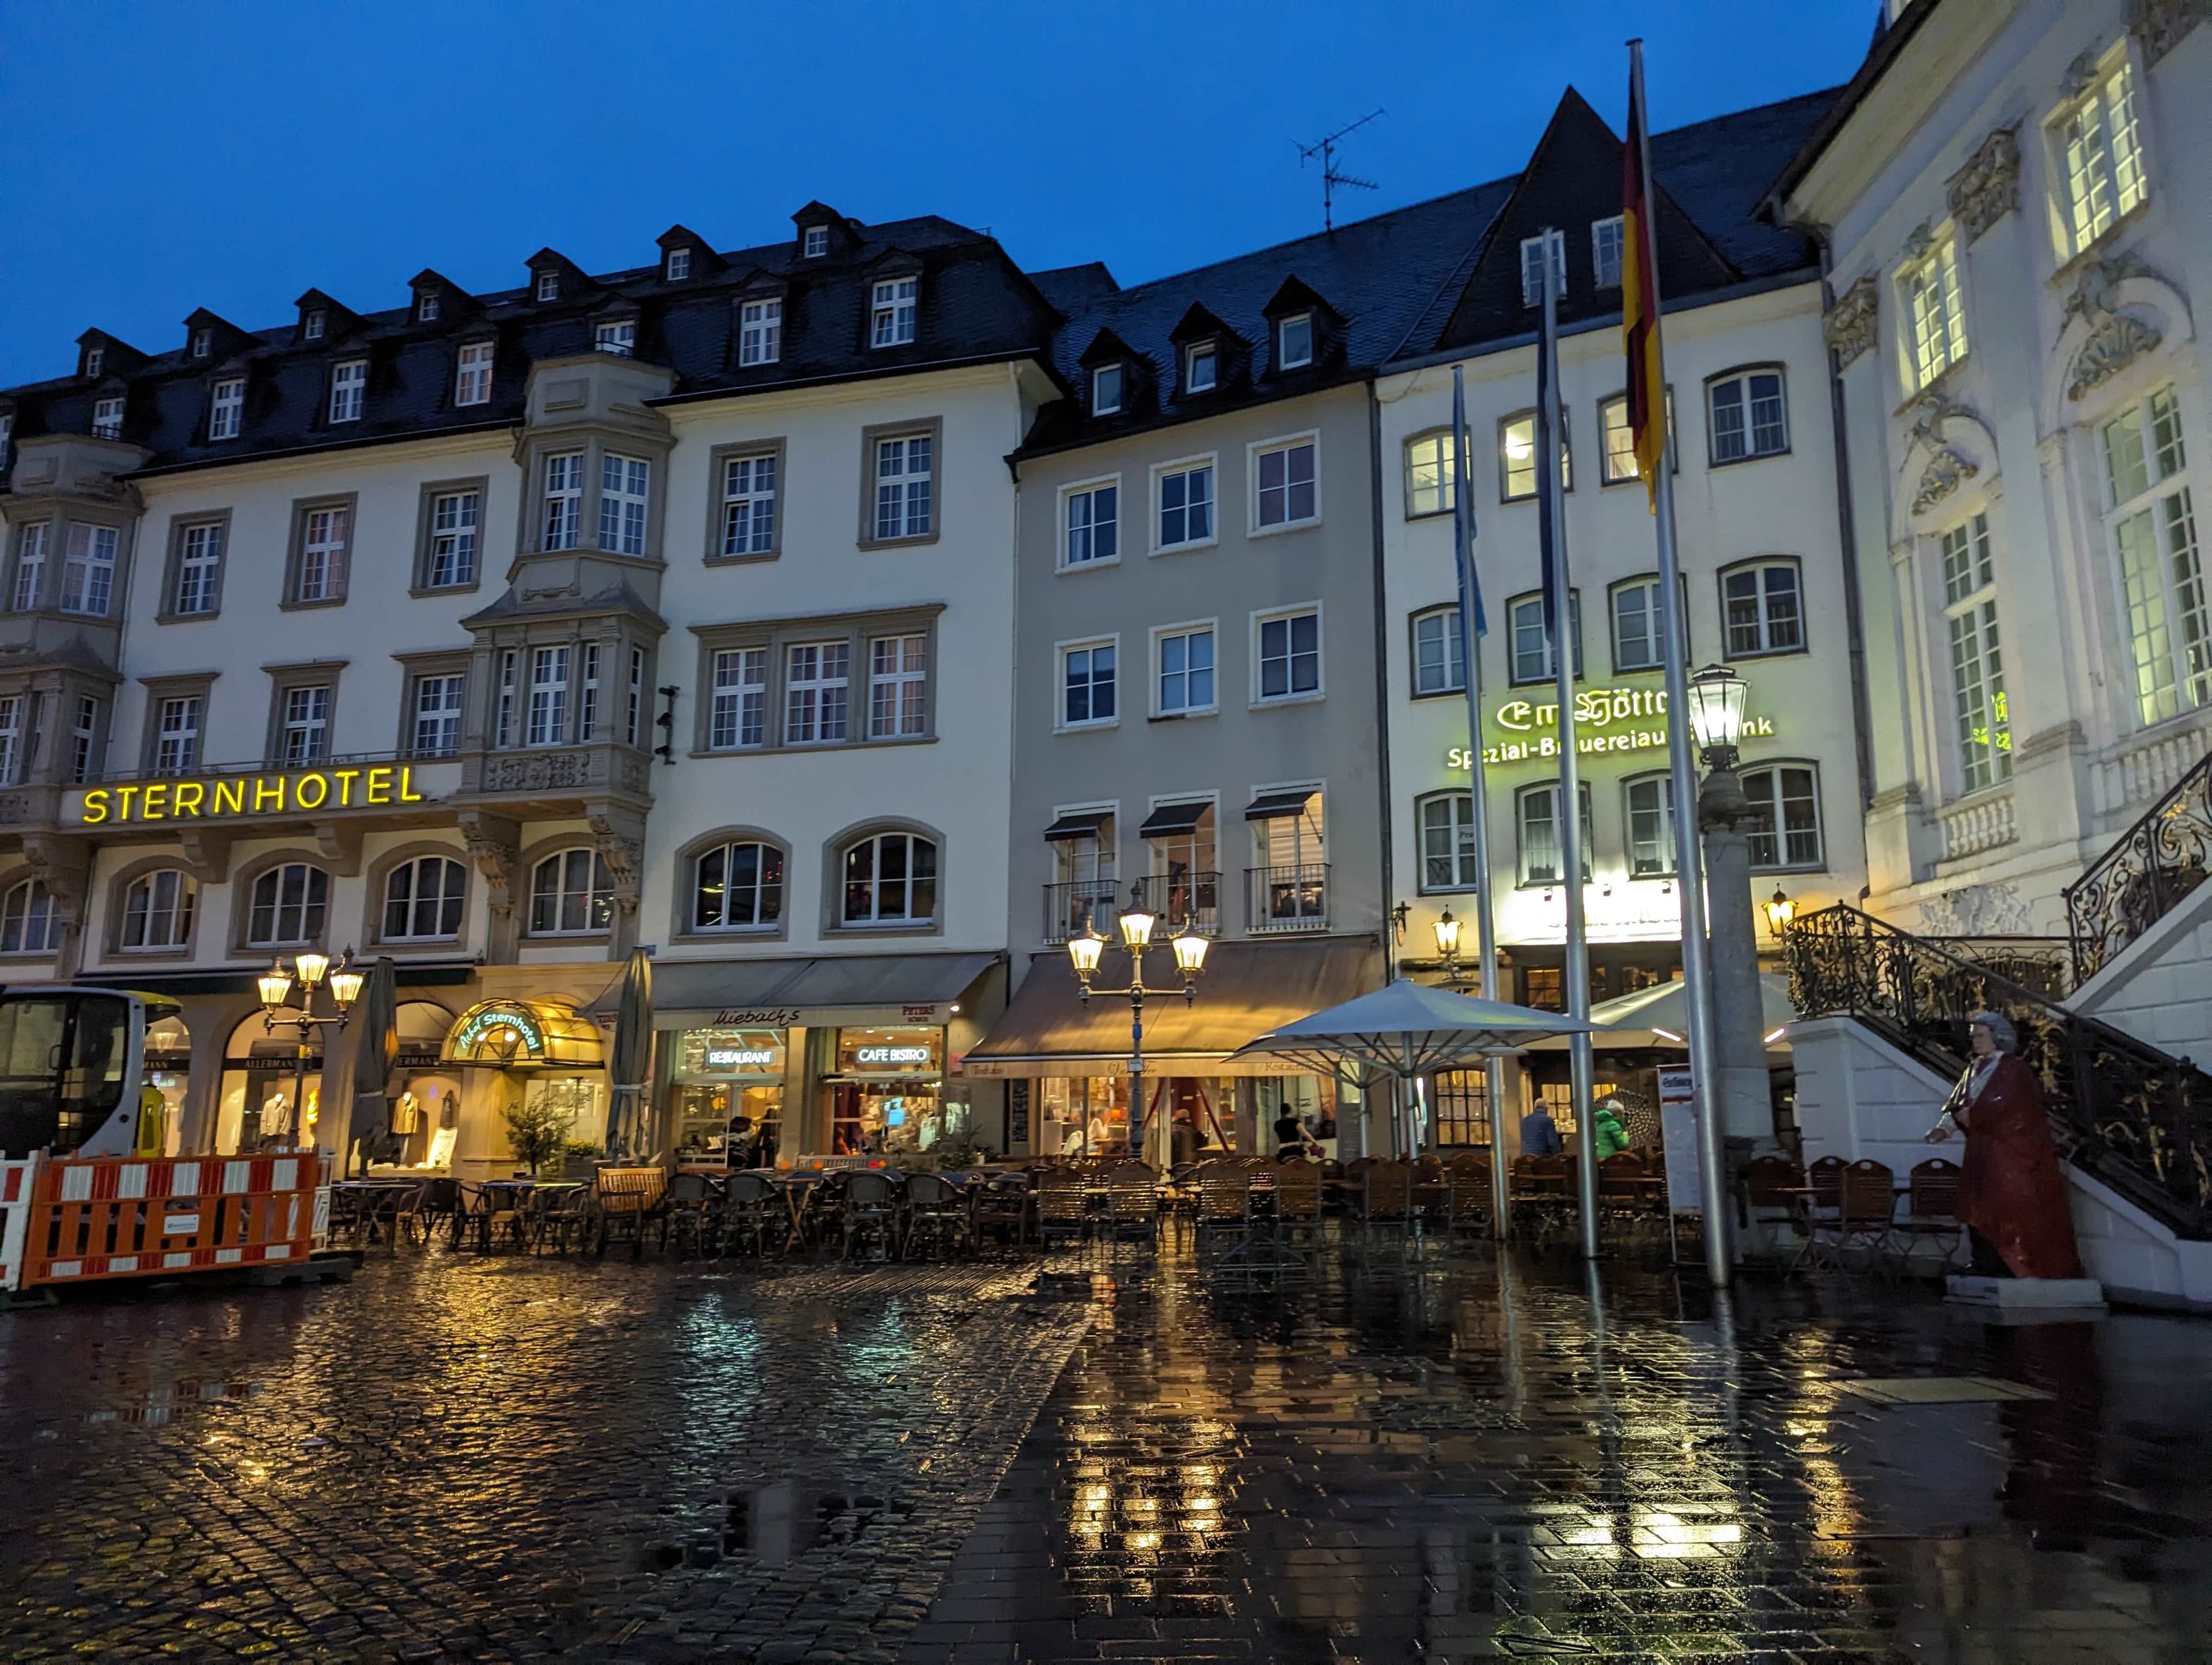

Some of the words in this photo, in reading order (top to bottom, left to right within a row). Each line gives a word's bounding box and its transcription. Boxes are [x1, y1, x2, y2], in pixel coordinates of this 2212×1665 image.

[82, 767, 421, 824] STERNHOTEL
[459, 1012, 486, 1049] Achat
[484, 1012, 540, 1050] Sternhotel
[709, 1051, 772, 1064] RESTAURANT
[858, 1049, 889, 1062] CAFE
[889, 1048, 927, 1061] BISTRO
[245, 1059, 295, 1069] ALLERMAN
